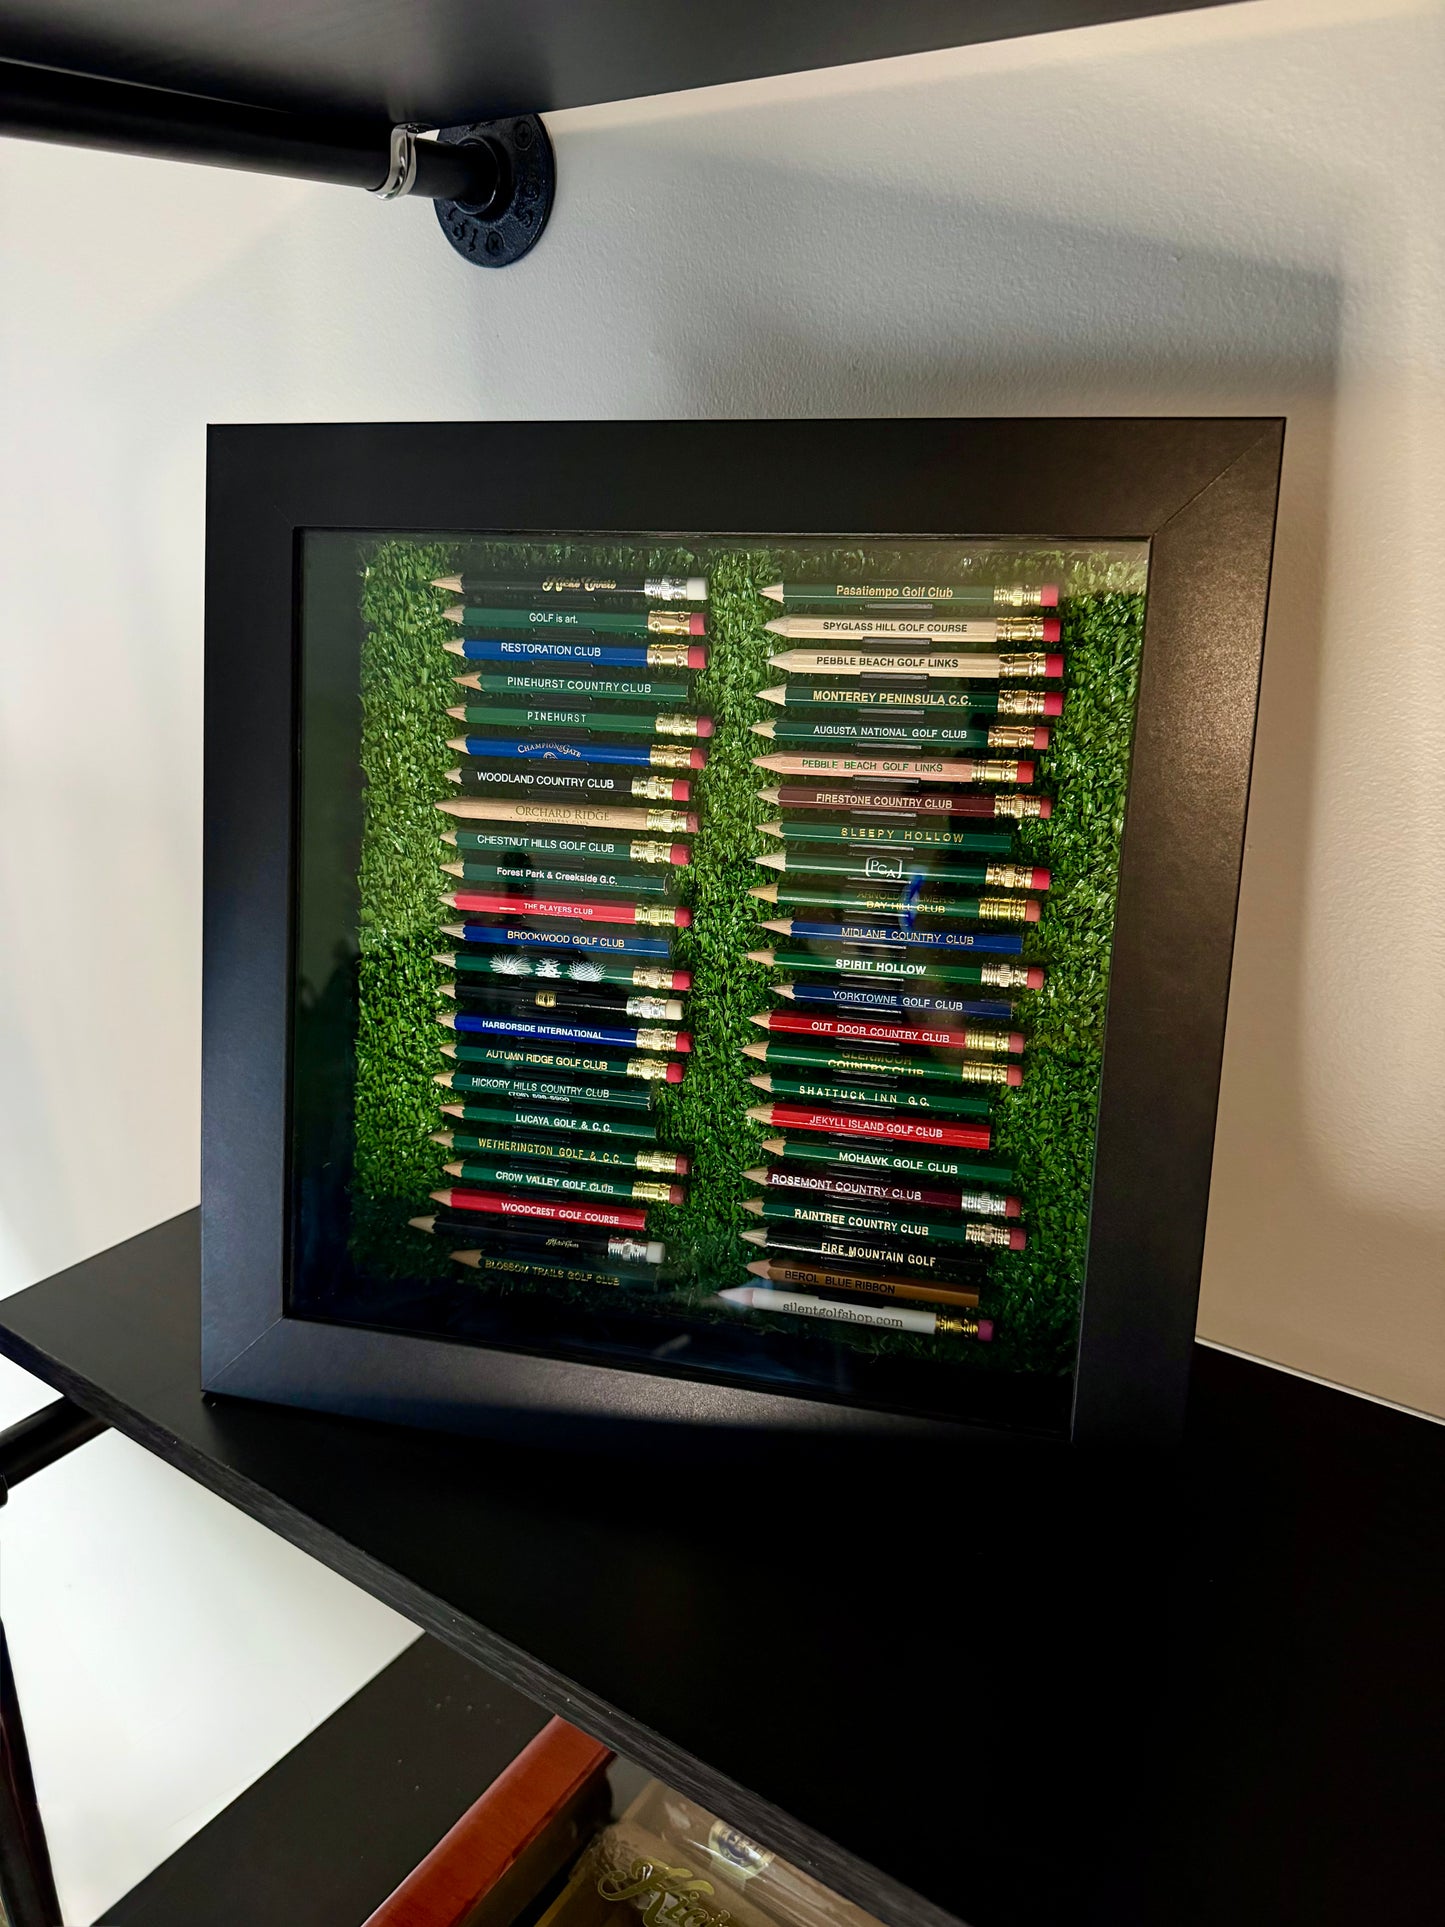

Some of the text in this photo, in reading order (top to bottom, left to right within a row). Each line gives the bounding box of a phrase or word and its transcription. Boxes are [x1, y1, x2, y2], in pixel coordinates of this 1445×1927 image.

[836, 585, 953, 598] Pasatiempo Golf Club
[530, 613, 578, 624] GOLF is art.
[823, 621, 968, 633] SPYGLASS HILL GOLF COURSE
[501, 643, 601, 657] RESTORATION CLUB
[816, 657, 959, 668] PEBBLE BEACH GOLF LINKS
[508, 677, 652, 693] PINEHURST COUNTRY CLUB
[813, 691, 971, 705] MONTEREY PENINSULA C.C.
[528, 711, 587, 723] PINEHURST
[814, 726, 967, 739] AUGUSTA NATIONAL GOLF CLUB
[802, 759, 943, 772] PEBBLE BEACH GOLF LINKS
[478, 772, 614, 789] WOODLAND COUNTRY CLUB
[816, 794, 953, 809] FIRESTONE COUNTRY CLUB
[516, 805, 610, 820] ORCHARD RIDGE
[478, 835, 614, 853] CHESTNUT HILLS GOLF CLUB
[841, 827, 964, 843] SLEEPY HOLLOW
[497, 867, 618, 885] Forest Park & Creekside G.C.
[871, 860, 895, 878] PGA
[540, 905, 572, 913] PLAYERS
[866, 901, 946, 913] BAY HILL CLUB
[508, 930, 625, 948] BROOKWOOD GOLF CLUB
[842, 927, 974, 945] MIDLANE COUNTRY CLUB
[836, 959, 926, 974] SPIRIT HOLLOW
[833, 991, 963, 1010] YORKTOWNE GOLF CLUB
[482, 1020, 602, 1039] HARBORSIDE INTERNATIONAL
[812, 1022, 950, 1043] OUT DOOR COUNTRY CLUB
[486, 1050, 608, 1070] AUTUMN RIDGE GOLF CLUB
[472, 1077, 610, 1098] HICKORY HILLS COUNTRY CLUB
[800, 1086, 929, 1106] SHATTUCK INN G.C.
[516, 1113, 550, 1125] LUCAYA
[554, 1118, 577, 1128] GOLF
[582, 1121, 588, 1130] &
[810, 1115, 943, 1138] JEKYLL ISLAND GOLF CLUB
[479, 1138, 623, 1163] WETHERINGTON GOLF & C.C.
[839, 1152, 958, 1174] MOHAWK GOLF CLUB
[496, 1171, 614, 1193] CROW VALLEY GOLF CLUB
[772, 1174, 922, 1200] ROSEMONT COUNTRY CLUB
[501, 1202, 619, 1224] WOODCREST GOLF COURSE
[795, 1209, 929, 1236] RAINTREE COUNTRY CLUB
[821, 1243, 936, 1267] FIRE MOUNTAIN GOLF
[485, 1259, 529, 1273] BLOSSOM
[568, 1271, 592, 1282] GOLF
[596, 1275, 620, 1286] CLUB
[785, 1271, 896, 1294] BEROL BLUE RIBBON
[783, 1302, 903, 1327] silentgolfshop.com
